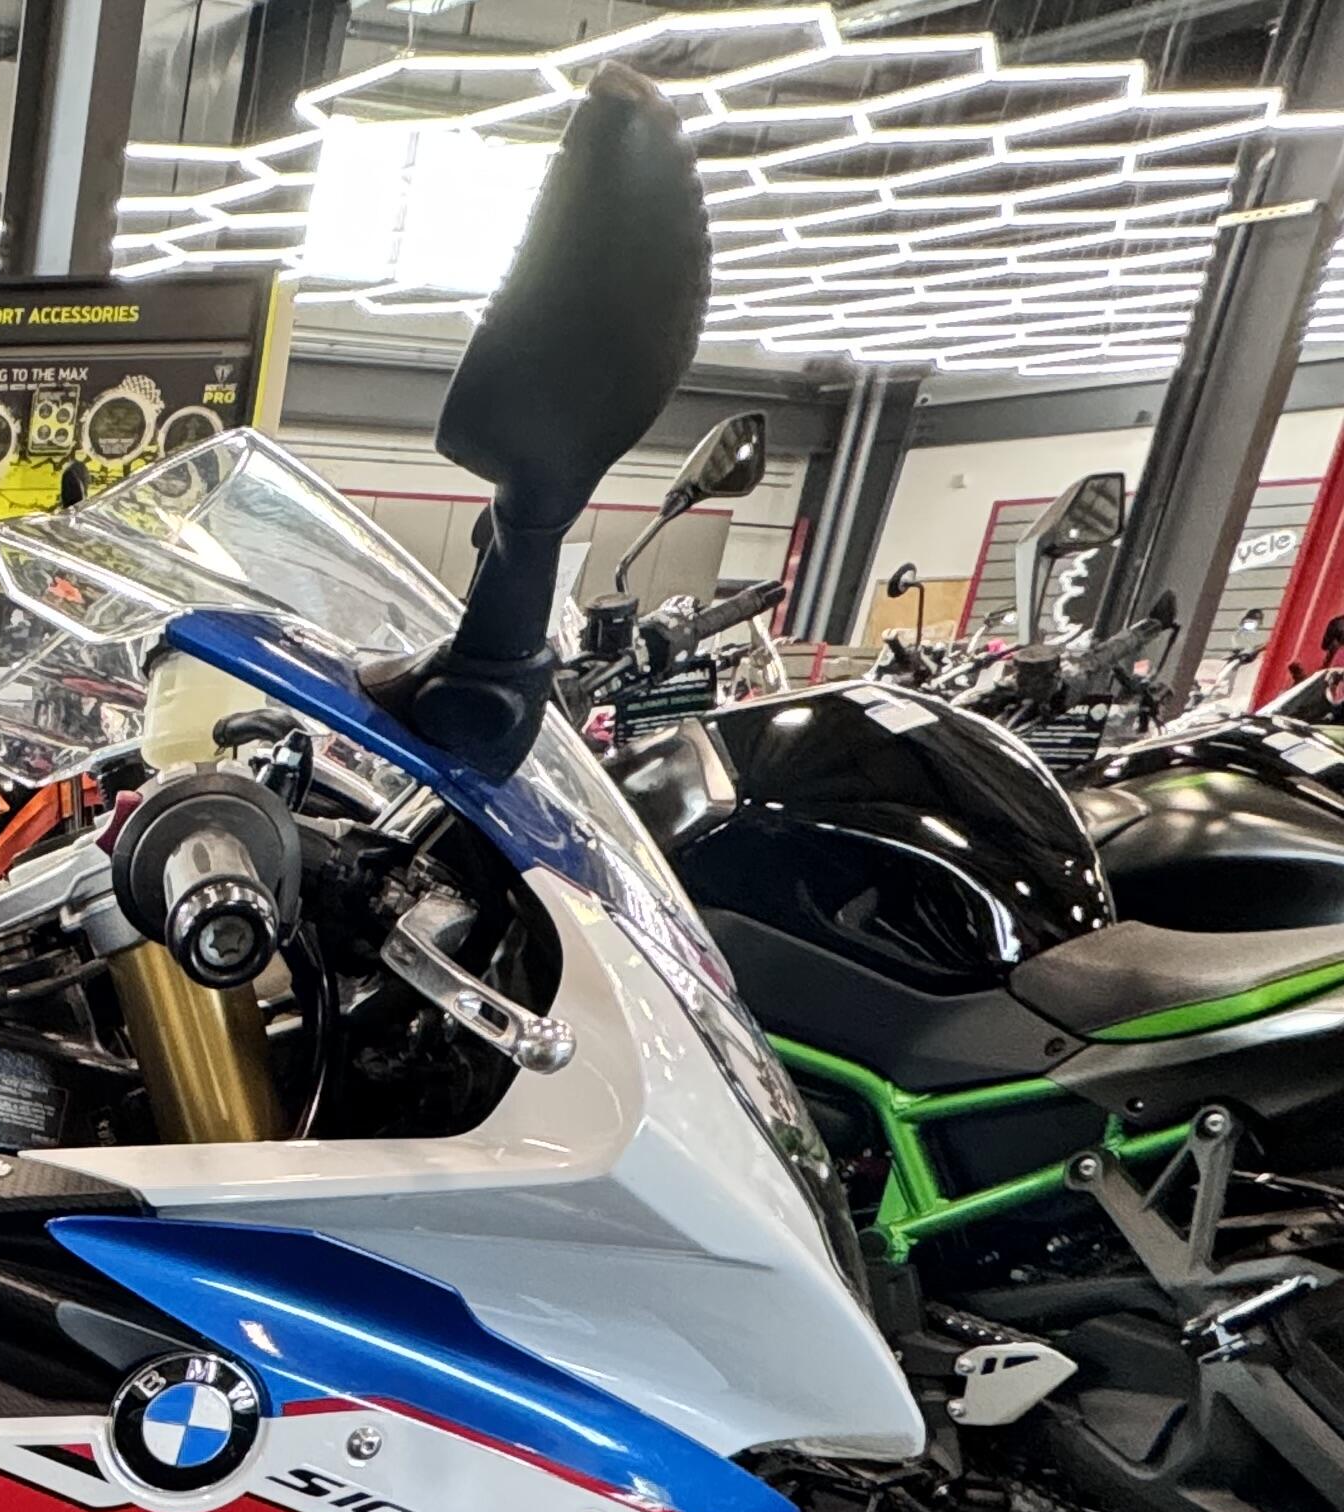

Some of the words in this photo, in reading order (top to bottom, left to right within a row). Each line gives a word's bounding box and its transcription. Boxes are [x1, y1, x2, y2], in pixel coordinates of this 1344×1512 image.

[28, 305, 141, 325] ACCESSORIES
[11, 368, 29, 382] TO
[32, 367, 56, 381] THE
[58, 367, 90, 381] MAX
[202, 391, 236, 405] PRO
[133, 1357, 256, 1412] BMW
